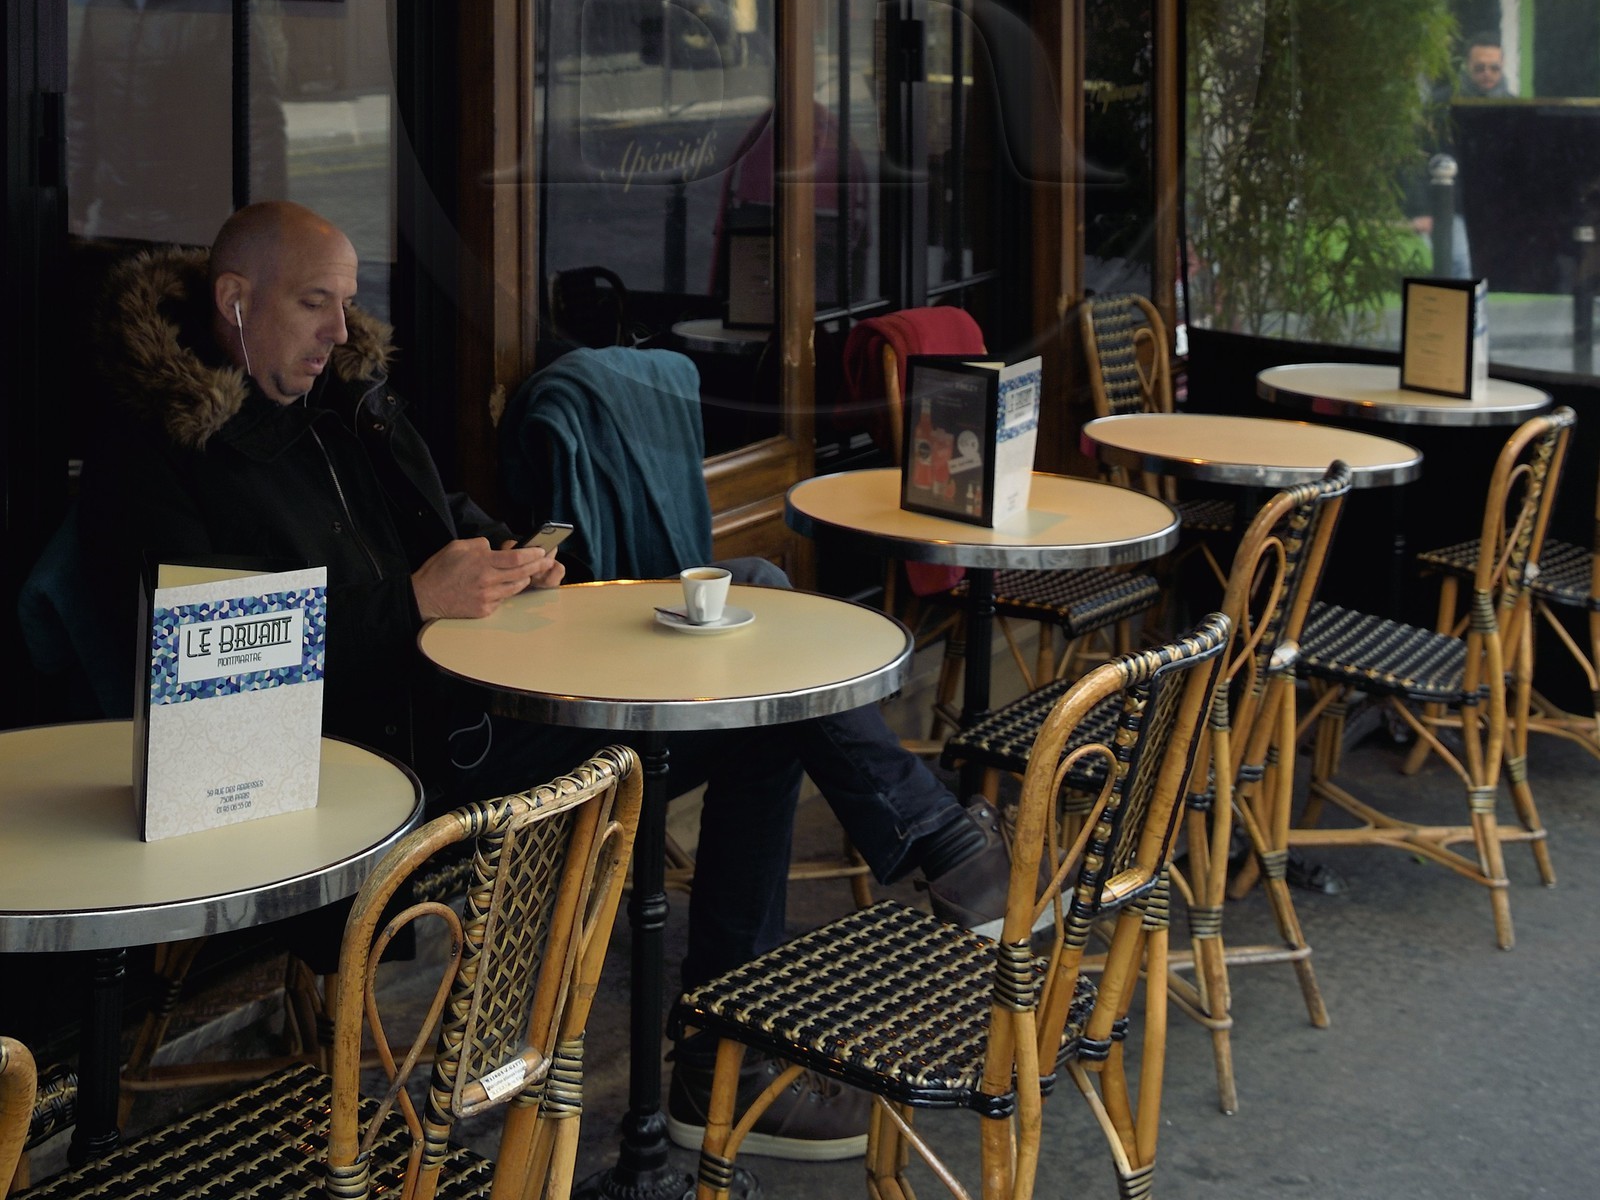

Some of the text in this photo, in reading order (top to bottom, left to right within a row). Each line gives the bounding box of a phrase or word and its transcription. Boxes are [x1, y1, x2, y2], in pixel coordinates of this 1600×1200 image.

[186, 616, 292, 658] LE BRUANT
[217, 651, 262, 668] MONTMARTRE
